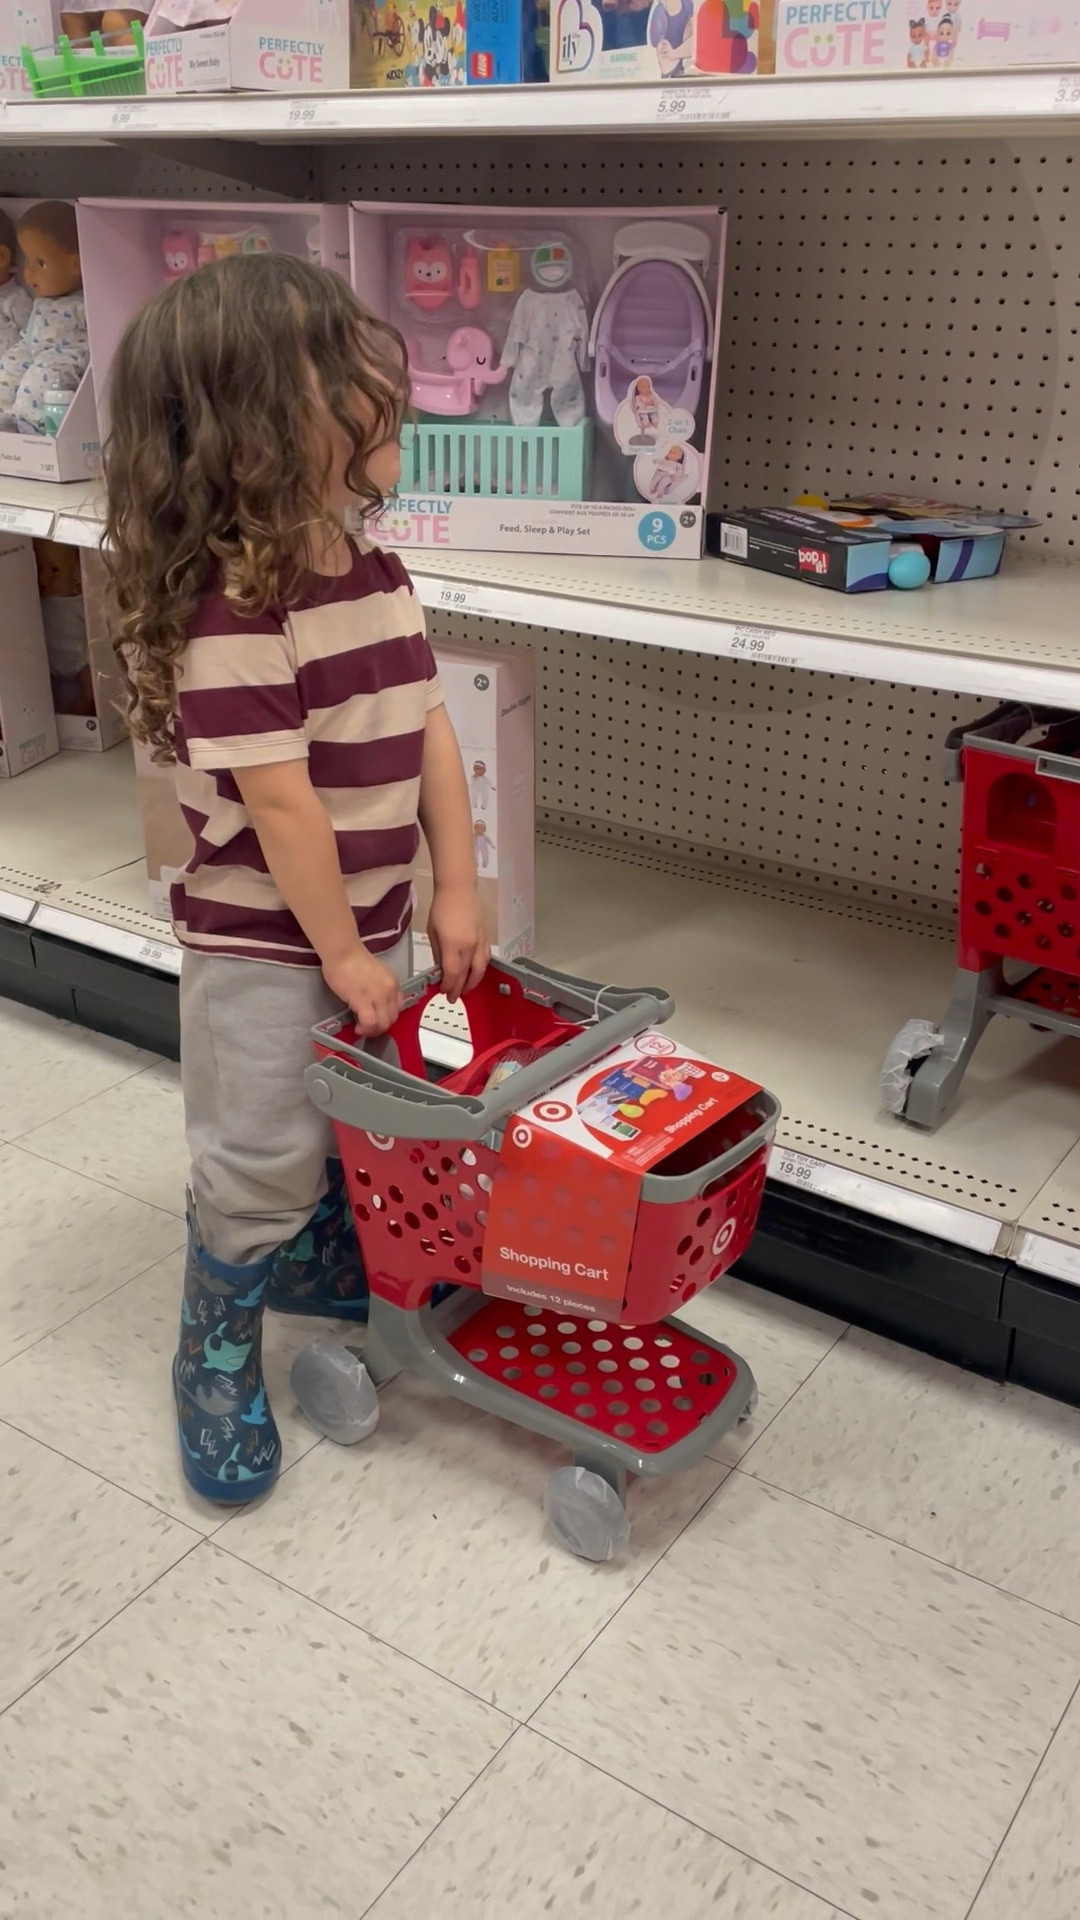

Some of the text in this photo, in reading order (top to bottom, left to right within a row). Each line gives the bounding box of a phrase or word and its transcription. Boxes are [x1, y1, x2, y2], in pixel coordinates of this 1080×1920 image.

[786, 0, 891, 25] PERFECTLY
[145, 37, 183, 56] PERFECTLY
[259, 36, 325, 55] PERFECTLY
[477, 53, 488, 78] LEGO
[1054, 89, 1080, 103] 3.9
[657, 100, 686, 112] 5.99
[289, 109, 315, 121] 19.99
[382, 499, 453, 514] ERFECTLY
[651, 518, 663, 533] 9
[682, 514, 694, 525] 2+
[499, 524, 591, 537] Feed, Sleep & Play Set
[646, 535, 667, 545] PCS
[798, 548, 819, 565] bop
[440, 591, 466, 603] 19.99
[731, 637, 765, 652] 24.99
[476, 677, 487, 687] 2+
[664, 1097, 718, 1134] Shopping Cart
[780, 1161, 812, 1179] 19.99
[500, 1247, 609, 1281] Shopping Cart
[506, 1284, 596, 1313] Includes 12 pieces
